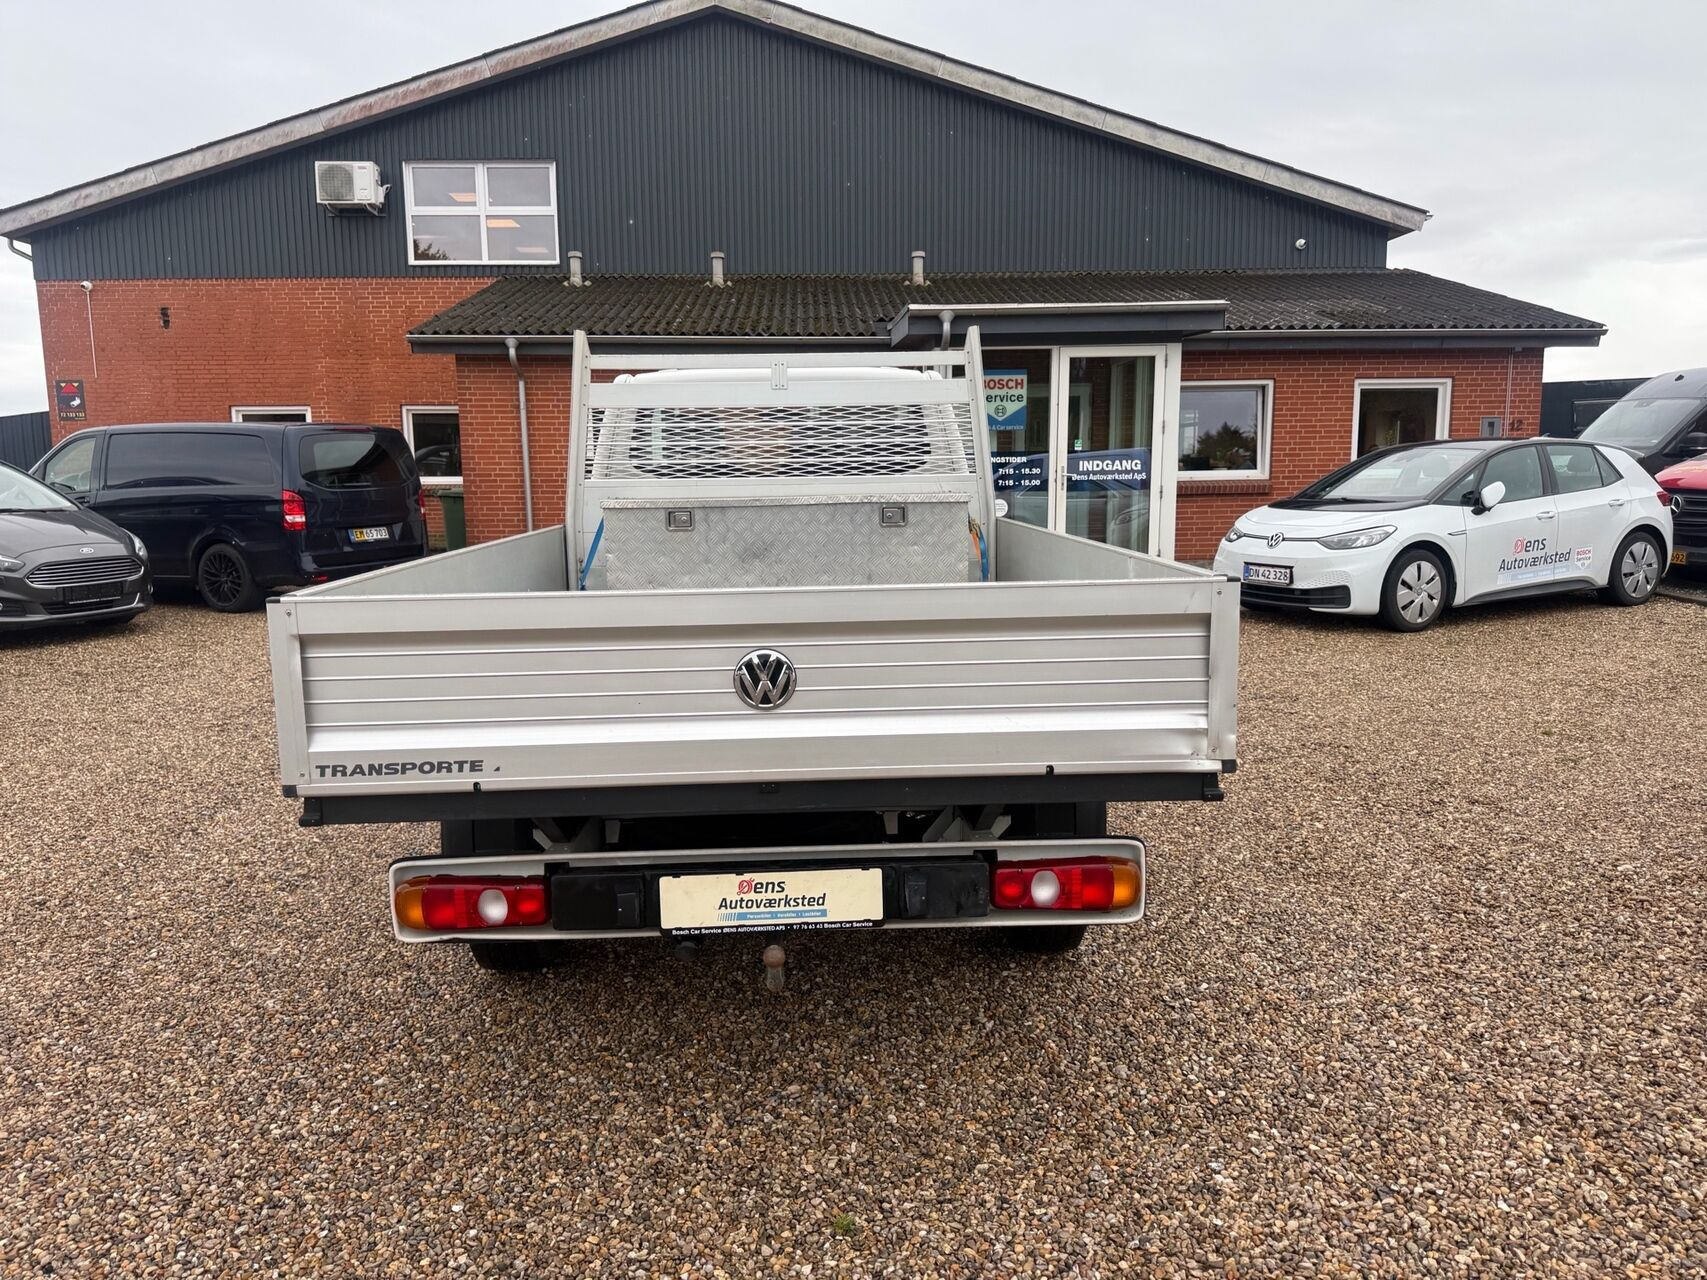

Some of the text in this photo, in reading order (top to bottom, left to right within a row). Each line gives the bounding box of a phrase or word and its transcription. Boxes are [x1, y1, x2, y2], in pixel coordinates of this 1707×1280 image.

[985, 391, 1025, 403] ervice
[1079, 459, 1142, 471] INDGANG
[1088, 472, 1133, 481] Autoværksted
[1133, 472, 1147, 481] ApS
[365, 529, 375, 538] 65
[374, 528, 388, 537] 703
[1498, 547, 1572, 573] Autoværksted
[1249, 567, 1289, 581] DN 42 328
[315, 759, 500, 777] TRANSPORTE
[737, 876, 786, 895] Øens
[718, 892, 827, 910] Autoværksted
